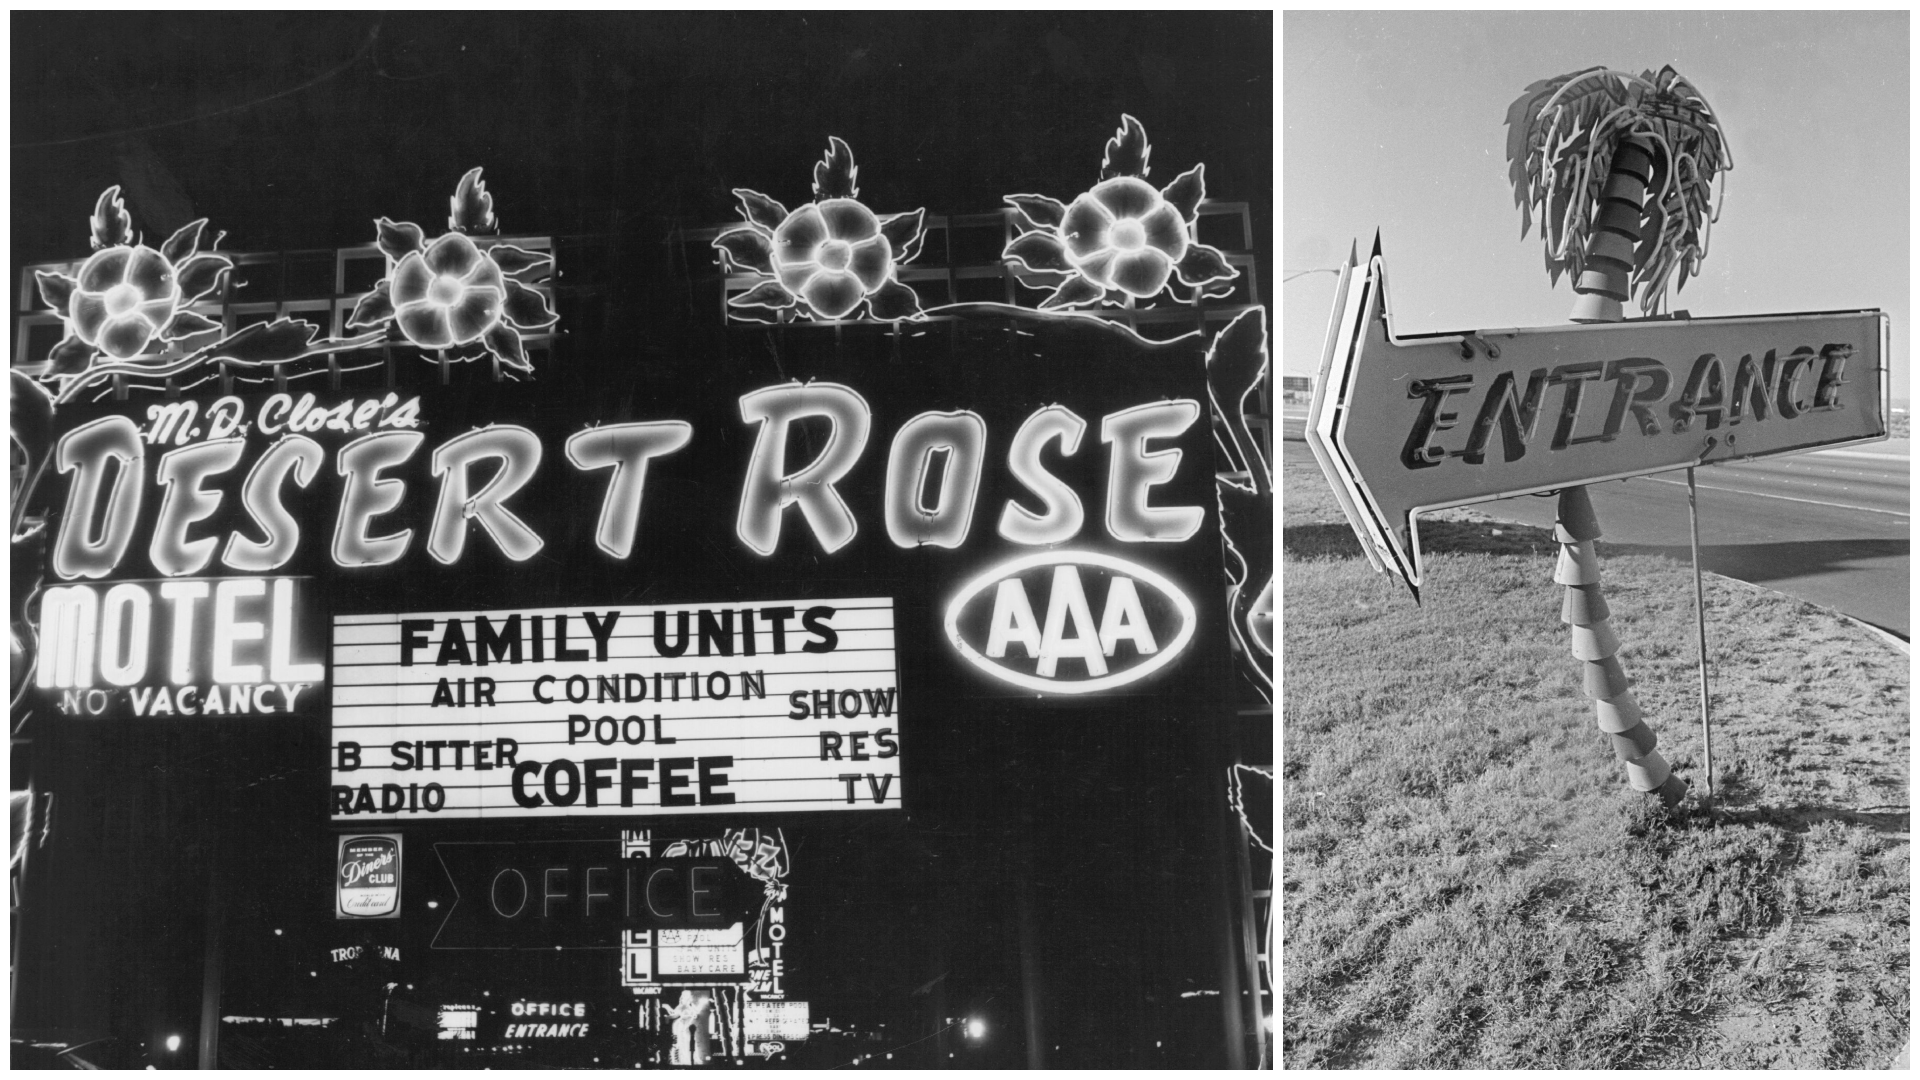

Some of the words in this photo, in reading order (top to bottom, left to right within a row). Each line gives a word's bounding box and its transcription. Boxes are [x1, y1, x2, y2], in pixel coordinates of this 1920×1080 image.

[257, 392, 421, 435] Close's
[1401, 343, 1859, 470] ENTRANCE
[736, 380, 1205, 556] ROSE
[53, 419, 695, 579] DESERT
[35, 579, 324, 687] MOTEL
[401, 611, 620, 667] FAMILY
[653, 606, 839, 659] UNITS
[985, 564, 1158, 678] AAA
[61, 688, 109, 716] NO
[128, 683, 304, 717] VACANCY
[431, 676, 497, 708] AIR
[532, 670, 766, 705] CONDITION
[788, 687, 896, 720] SHOW
[568, 714, 676, 745] POOL
[819, 728, 898, 762] RES
[337, 741, 362, 772] B
[390, 737, 519, 771] SITTER
[330, 782, 446, 816] RADIO
[511, 755, 736, 809] COFFEE
[838, 773, 893, 804] TV
[368, 873, 395, 884] CLUB
[490, 867, 722, 918] OFFICE
[708, 954, 729, 963] RES
[769, 906, 786, 994] MOTEL
[708, 964, 736, 973] CARE
[511, 1002, 586, 1016] OFFICE
[504, 1023, 590, 1038] ENTRANCE
